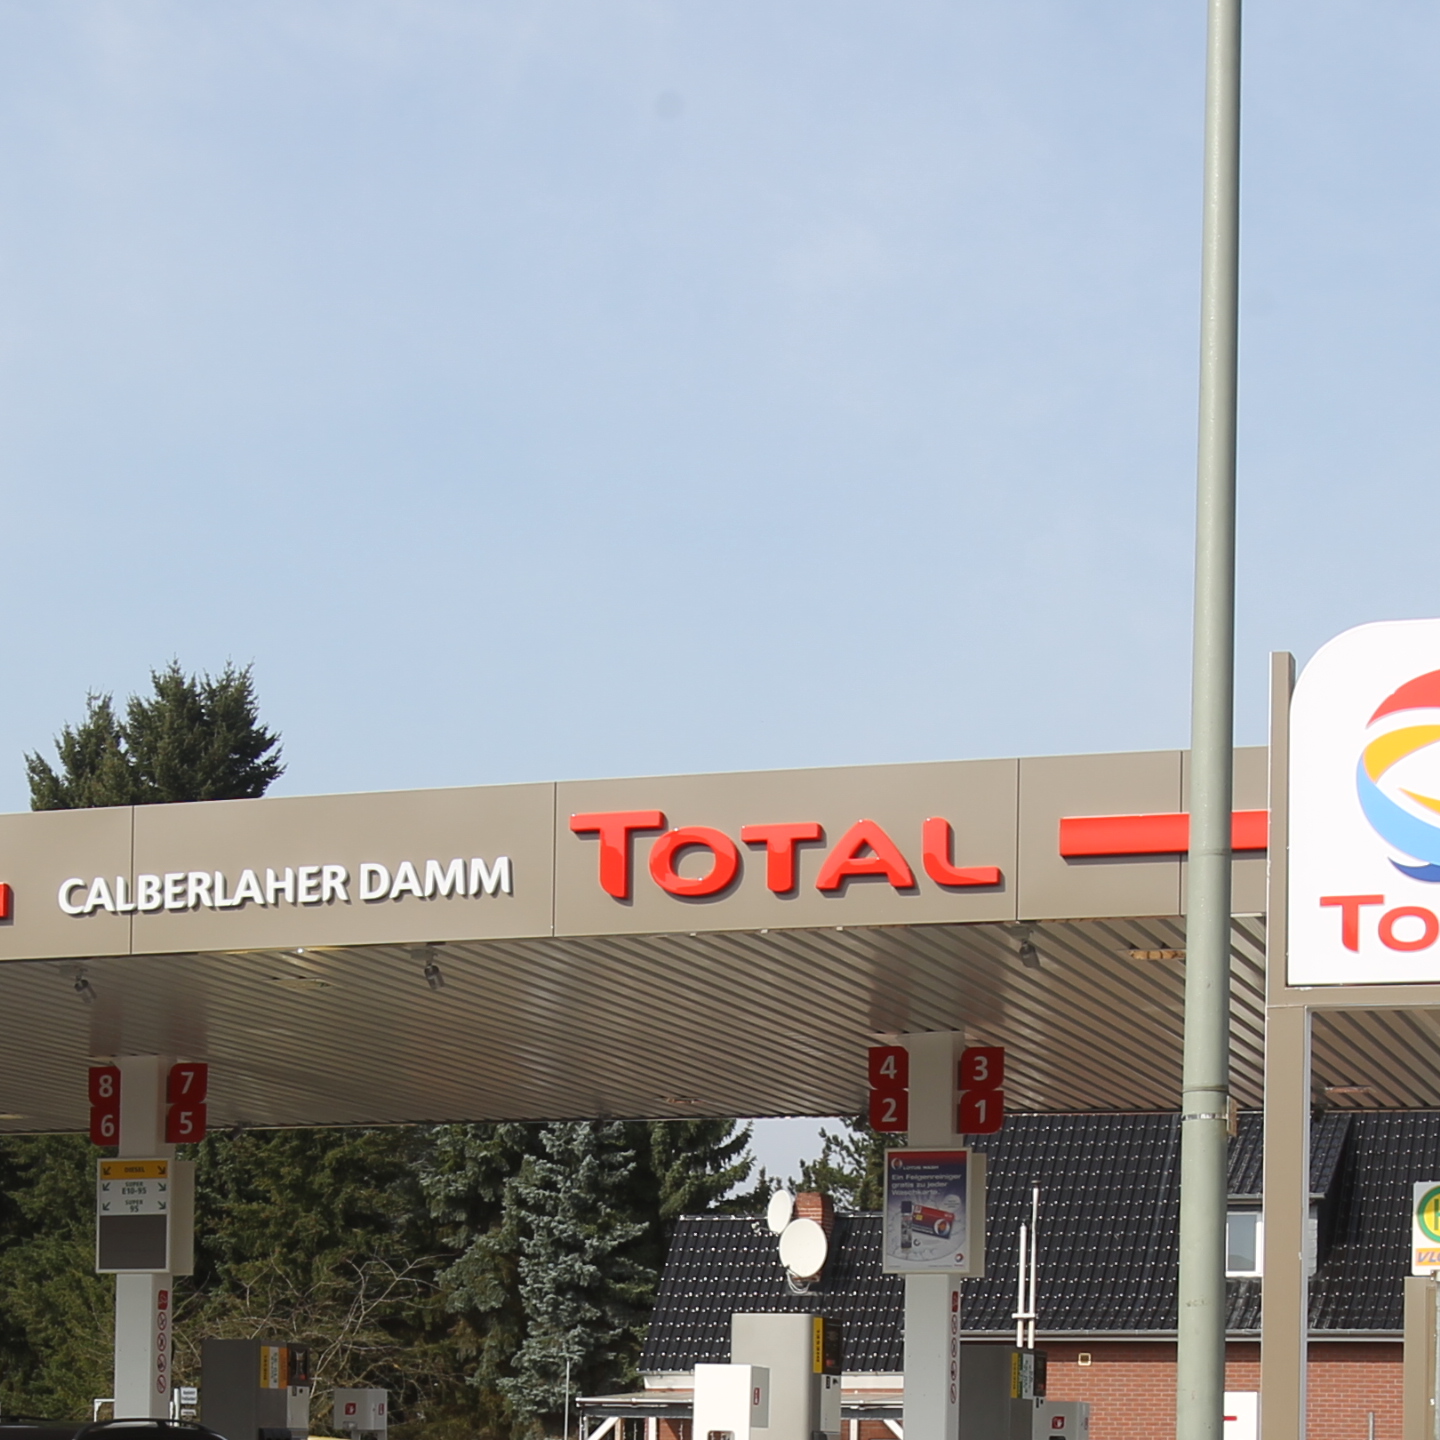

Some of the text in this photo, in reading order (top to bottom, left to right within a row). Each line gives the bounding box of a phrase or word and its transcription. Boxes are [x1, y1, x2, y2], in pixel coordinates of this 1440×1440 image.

[569, 809, 1002, 899] TOTAL
[58, 856, 511, 915] CALBERLAHER DAMM
[880, 1055, 897, 1079] 4
[972, 1056, 989, 1081] 3
[99, 1075, 113, 1097] 8
[180, 1071, 195, 1095] 7
[881, 1098, 898, 1123] 2
[974, 1099, 987, 1124] 1
[101, 1114, 114, 1137] 6
[179, 1111, 193, 1135] 5
[122, 1187, 147, 1195] E10-95
[927, 1181, 948, 1189] jeder
[130, 1205, 139, 1213] 95
